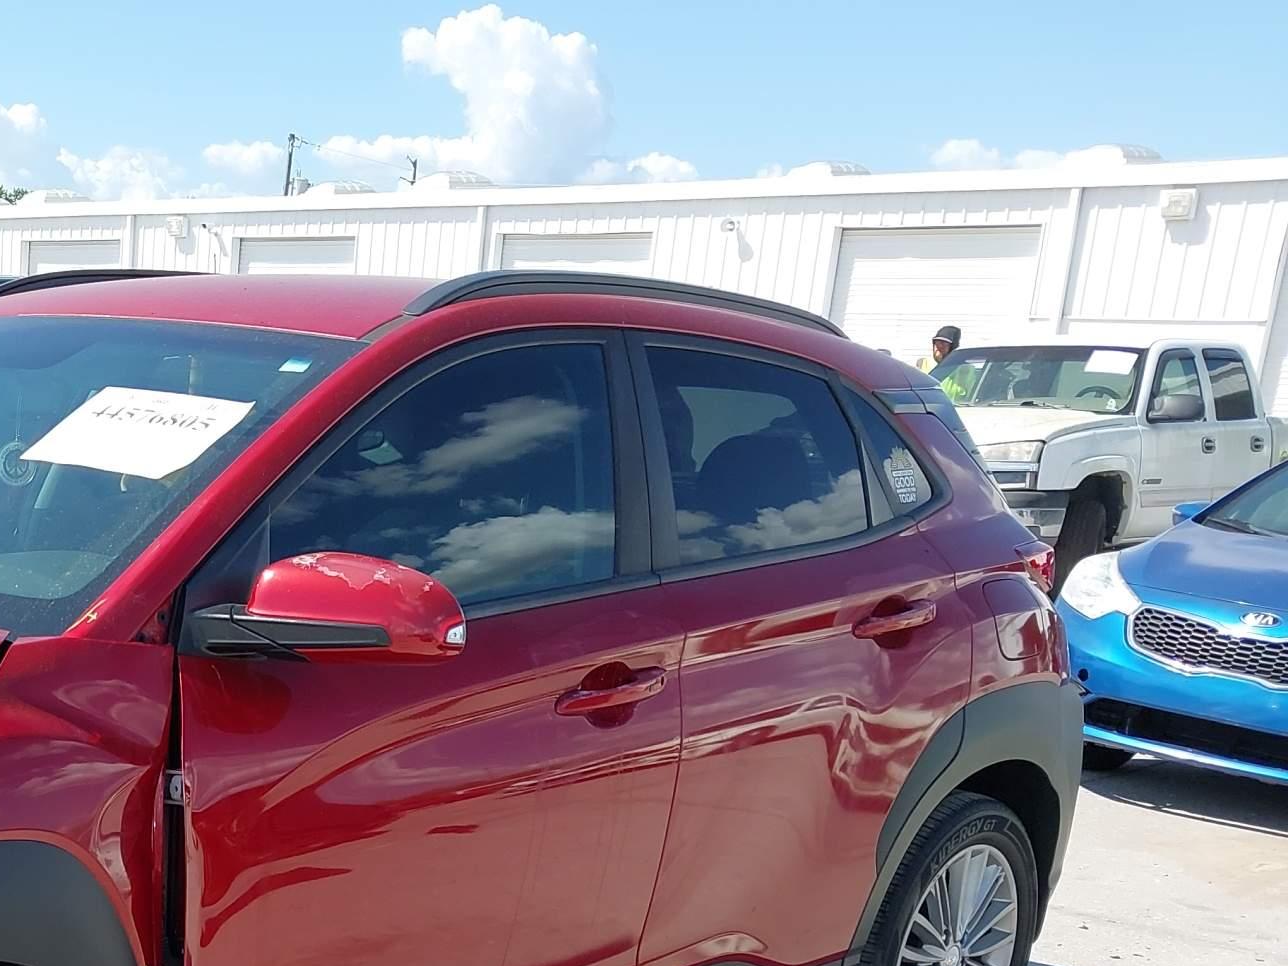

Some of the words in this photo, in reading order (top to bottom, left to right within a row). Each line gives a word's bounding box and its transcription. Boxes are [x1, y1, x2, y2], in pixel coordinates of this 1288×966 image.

[92, 405, 216, 431] 44576805
[895, 476, 915, 488] GOOD
[899, 493, 916, 504] TODAY
[1243, 612, 1274, 626] KIA
